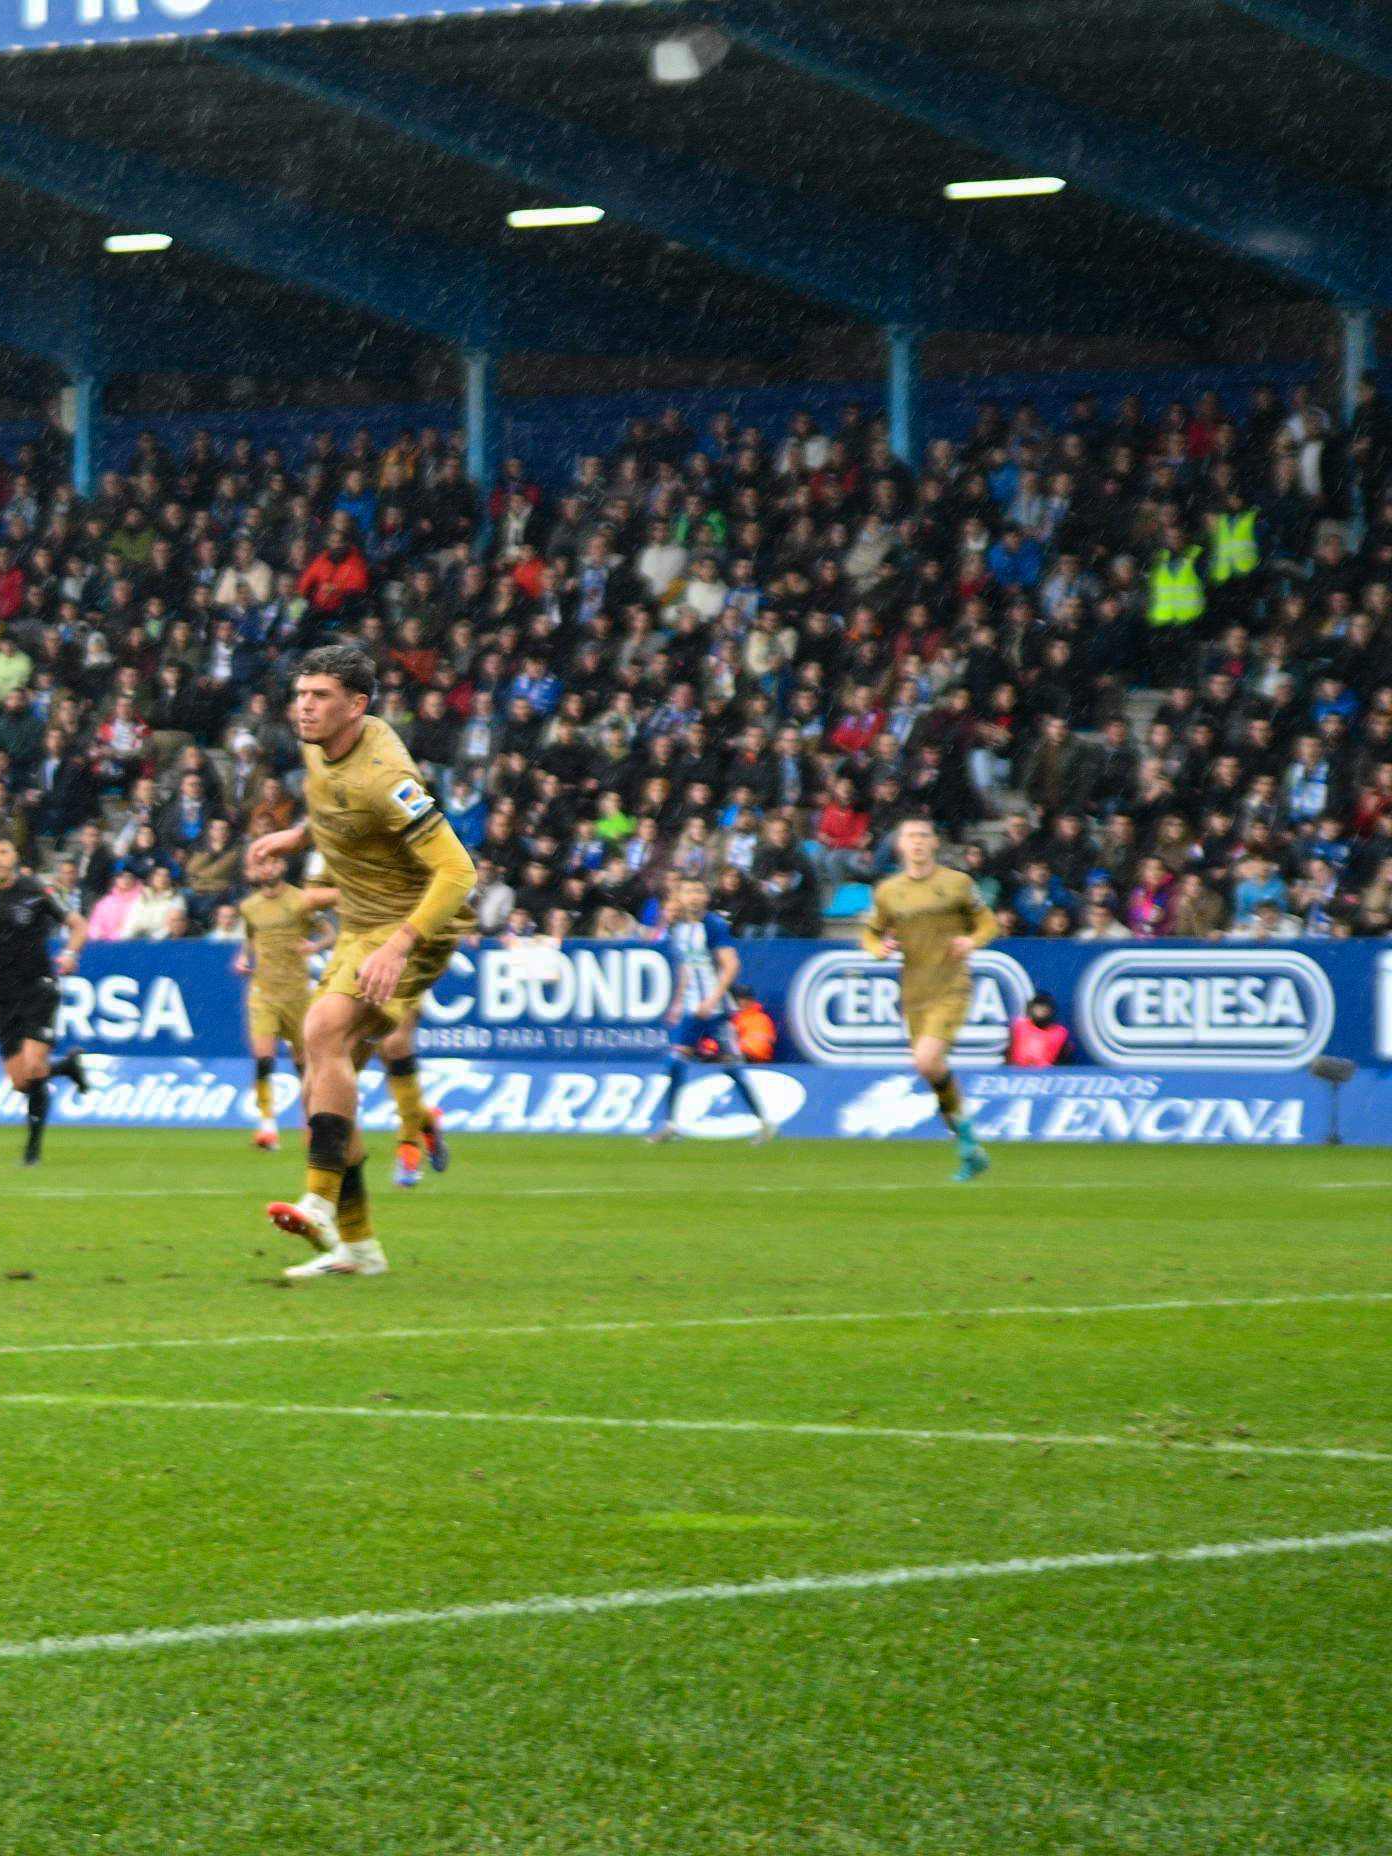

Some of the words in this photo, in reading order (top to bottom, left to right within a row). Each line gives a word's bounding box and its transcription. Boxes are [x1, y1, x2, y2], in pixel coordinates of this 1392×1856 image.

[416, 1025, 492, 1048] DISEÑO
[496, 1028, 547, 1048] PARA
[553, 1029, 578, 1048] TU
[582, 1029, 671, 1049] FACHADA
[970, 1074, 1163, 1096] EMBUTIDOS
[1042, 1096, 1306, 1139] ENCINA
